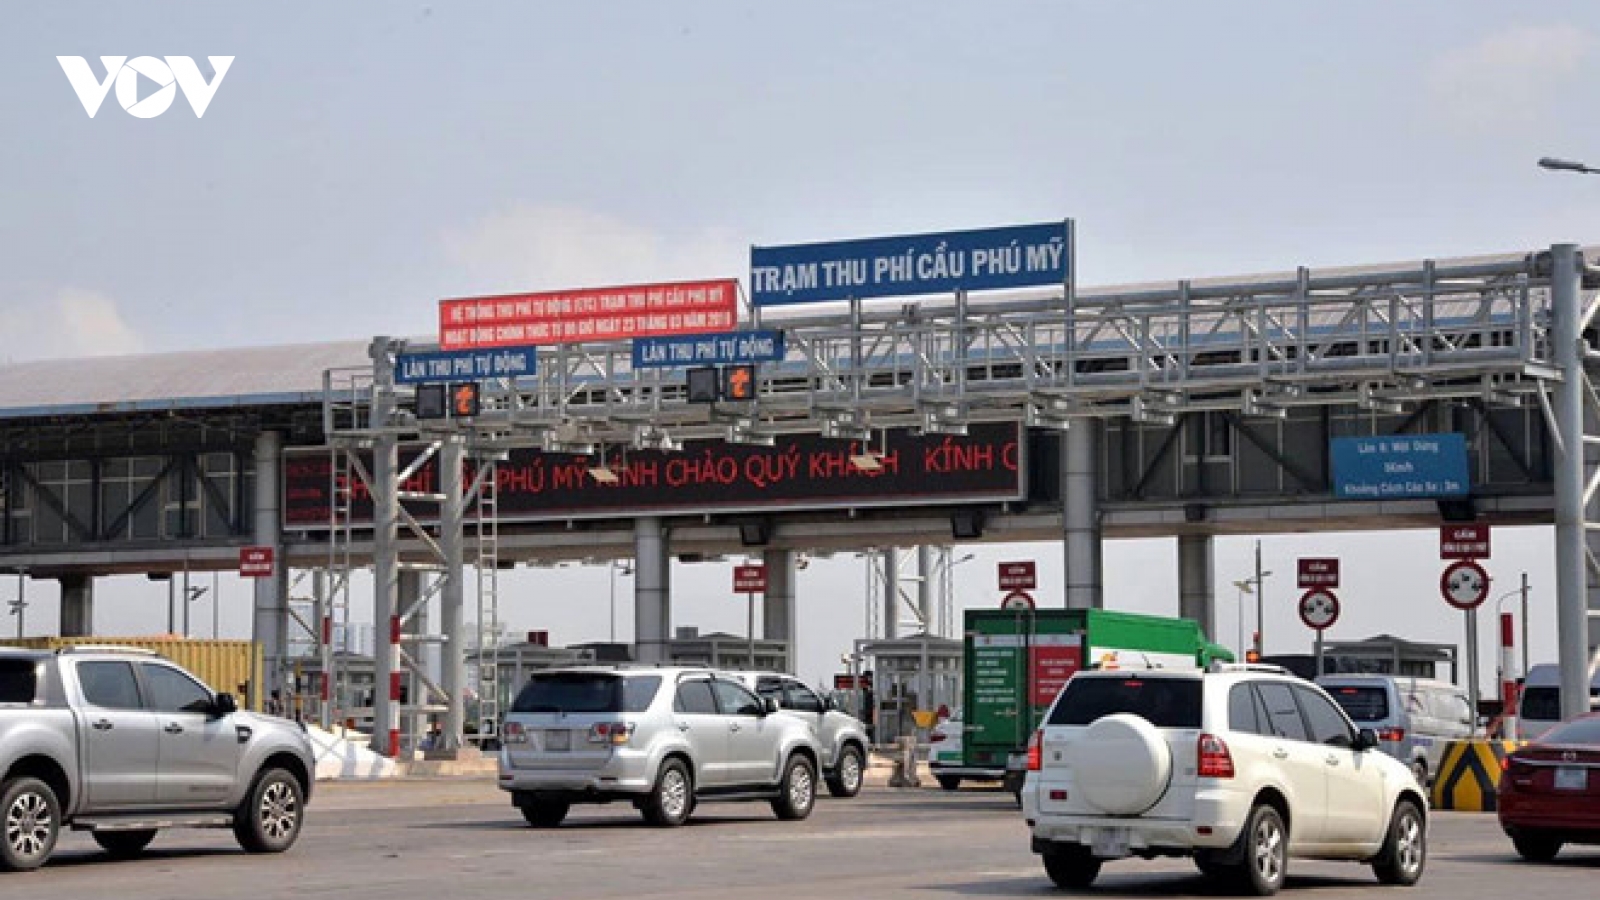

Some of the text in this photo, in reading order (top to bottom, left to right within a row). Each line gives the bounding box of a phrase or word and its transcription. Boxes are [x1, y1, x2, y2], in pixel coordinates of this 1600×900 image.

[752, 263, 817, 295] TRẠM
[822, 259, 867, 287] THU
[874, 248, 914, 283] PHÍ
[971, 239, 1021, 277] PHÚ
[1027, 236, 1063, 272] MỸ
[428, 359, 452, 377] THU
[453, 353, 473, 375] PHÍ
[668, 342, 694, 360] THU
[696, 336, 717, 359] PHÍ
[740, 333, 774, 358] ĐỘNG
[497, 459, 544, 493] PHÚ
[553, 456, 588, 490] MỸ
[666, 449, 738, 487] CHÀO
[745, 446, 801, 487] QUÝ
[925, 436, 993, 472] KÍNH
